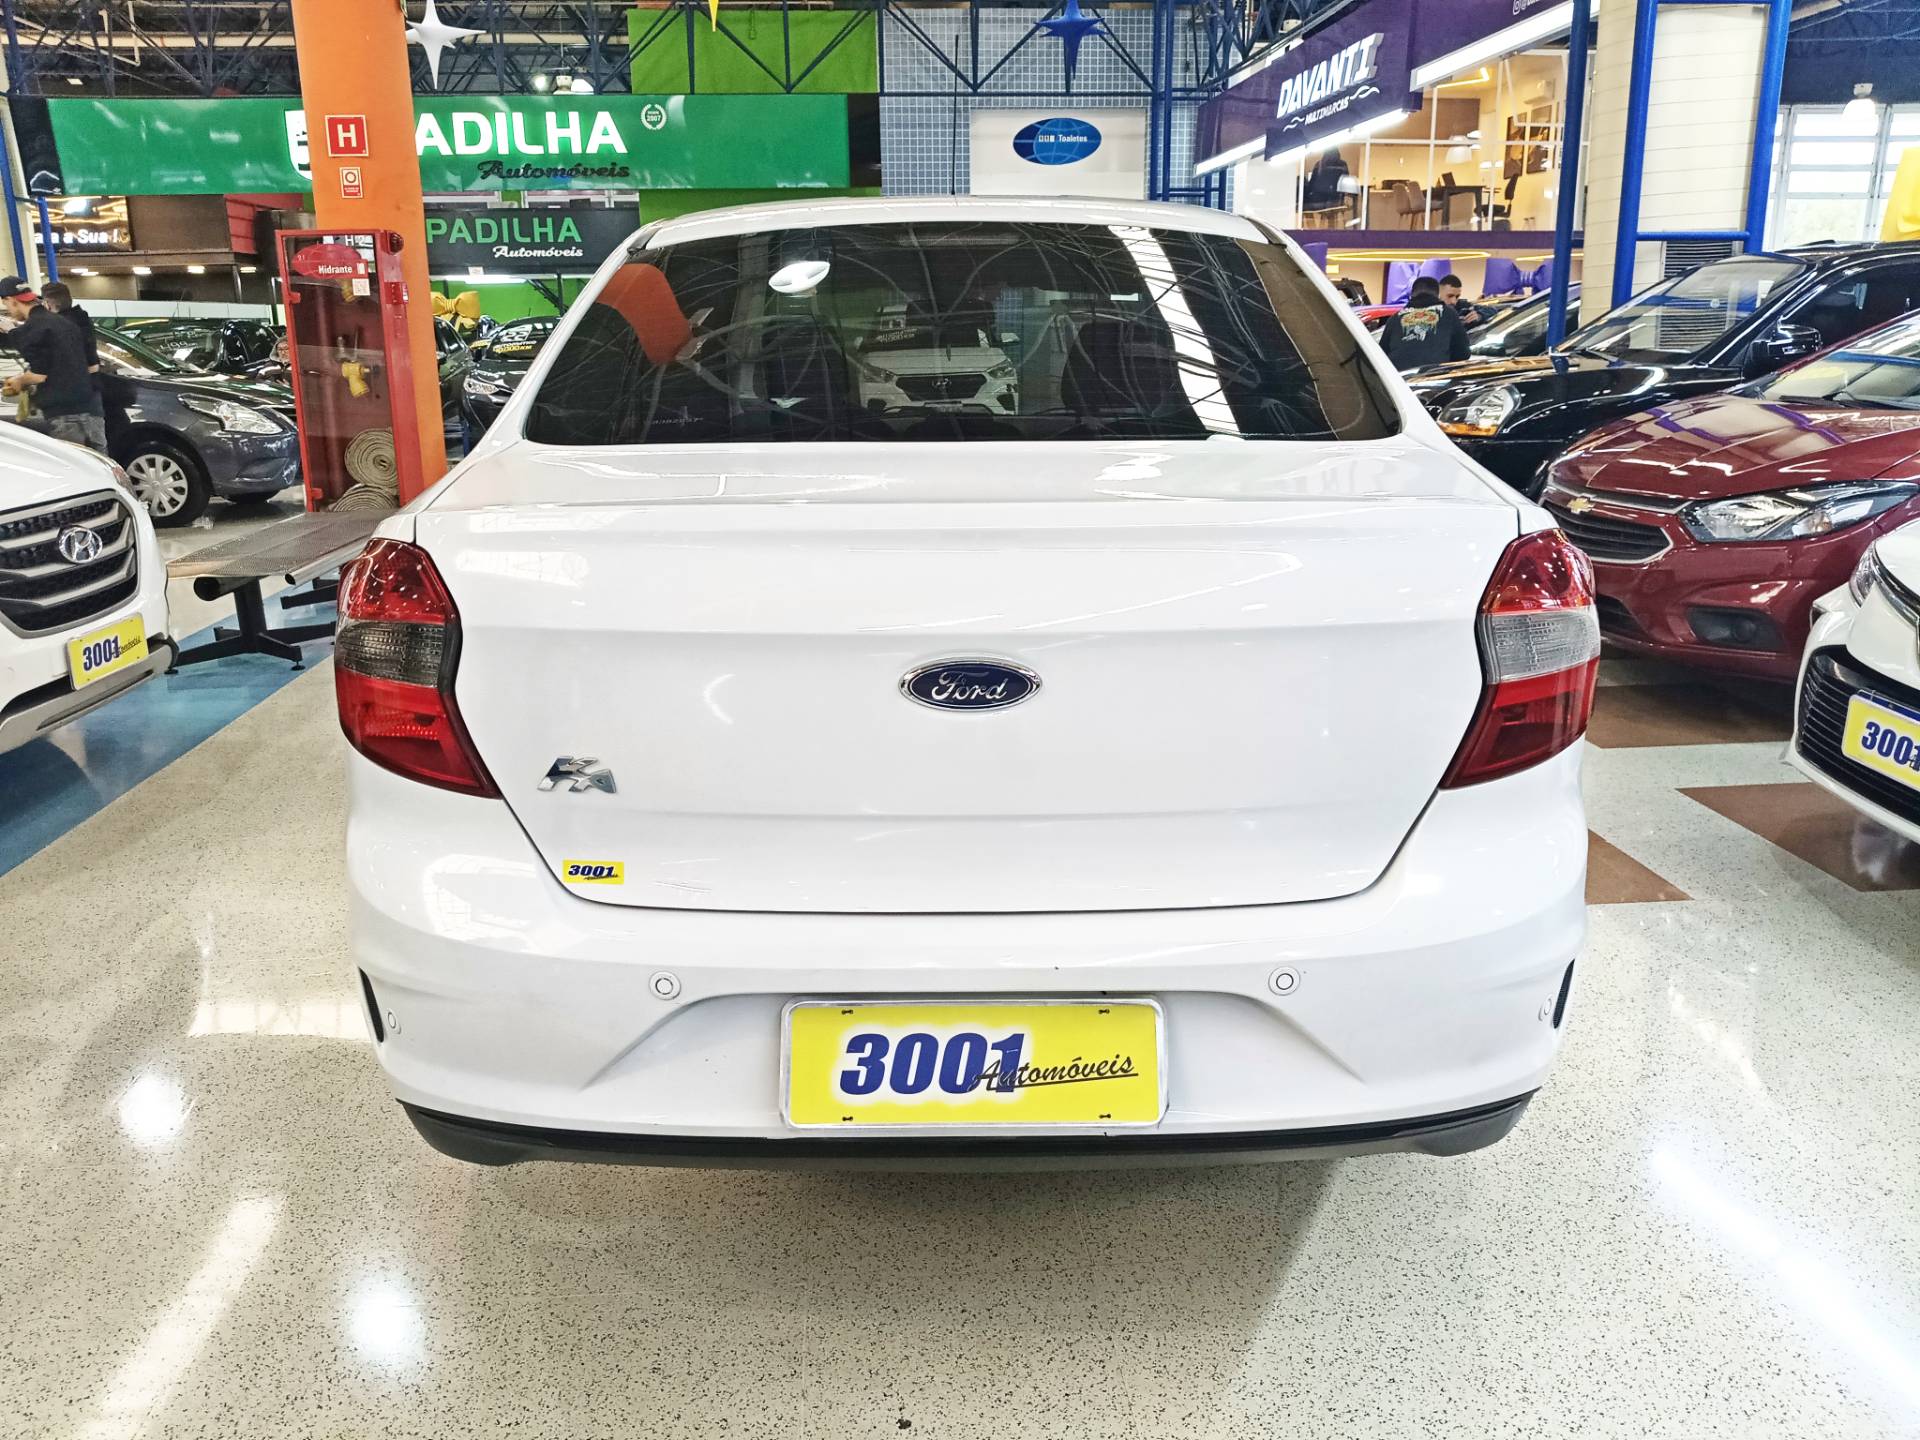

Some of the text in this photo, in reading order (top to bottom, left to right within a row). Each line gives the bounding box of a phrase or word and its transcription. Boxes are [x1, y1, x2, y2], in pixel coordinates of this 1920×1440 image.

[1277, 33, 1384, 119] DAVANTI
[1305, 96, 1350, 125] MULTIMARCAS
[337, 124, 357, 148] H
[415, 111, 628, 156] ADILHA
[1058, 134, 1088, 142] Toaletes
[477, 160, 630, 180] Automóveis
[77, 229, 108, 244] Sua
[426, 217, 582, 244] PADILHA
[492, 246, 583, 259] Automóveis
[318, 265, 353, 274] Hidrante
[83, 635, 120, 671] 3001
[931, 671, 1009, 700] Ford
[568, 864, 614, 877] 3001
[839, 1032, 1138, 1096] 3001 Automóveis
